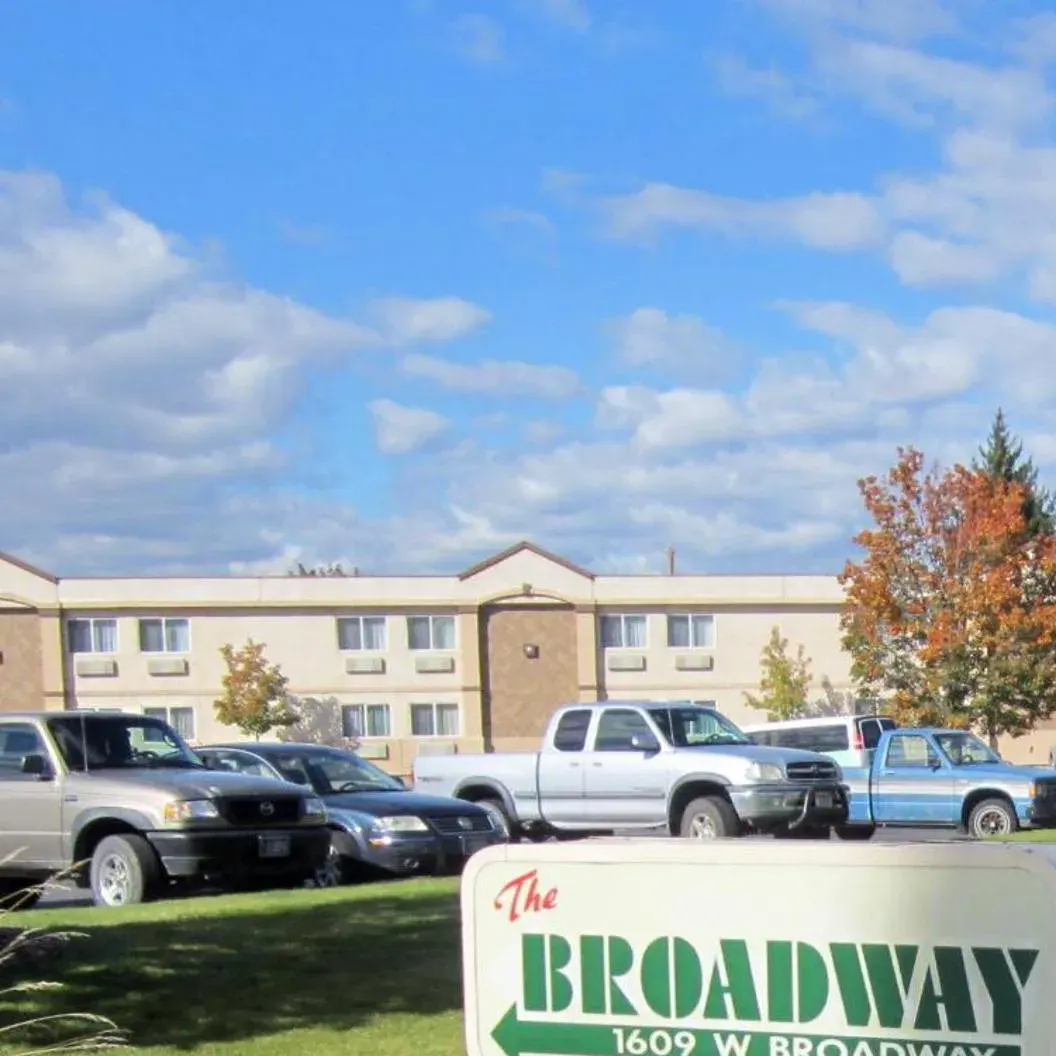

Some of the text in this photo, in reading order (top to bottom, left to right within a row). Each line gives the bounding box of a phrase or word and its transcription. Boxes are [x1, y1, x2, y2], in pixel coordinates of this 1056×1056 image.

[494, 869, 559, 923] The
[521, 932, 1040, 1035] BROADWAY
[612, 1026, 696, 1056] 1609
